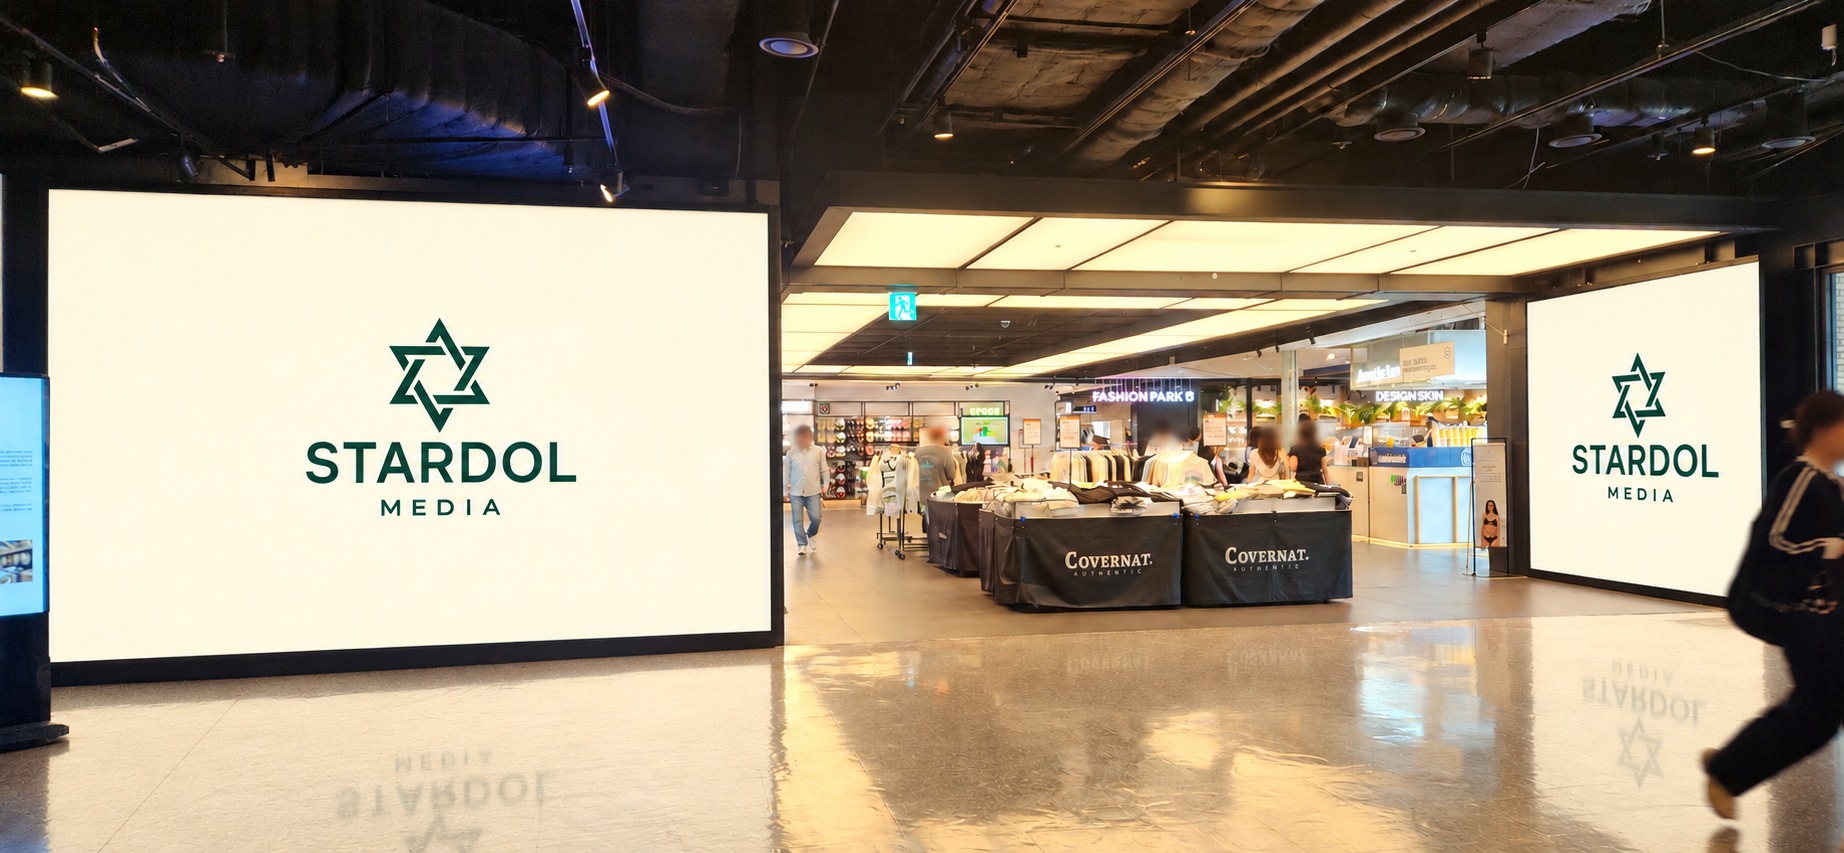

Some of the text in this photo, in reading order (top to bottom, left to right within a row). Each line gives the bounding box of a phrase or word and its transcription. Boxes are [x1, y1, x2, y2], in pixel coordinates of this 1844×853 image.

[1092, 391, 1183, 402] FASHION PARK
[1375, 390, 1444, 402] DESIGN SKIN
[306, 442, 576, 484] STARDOL
[1573, 443, 1719, 478] STARDOL
[1608, 487, 1673, 503] MEDIA
[381, 499, 501, 516] MEDIA
